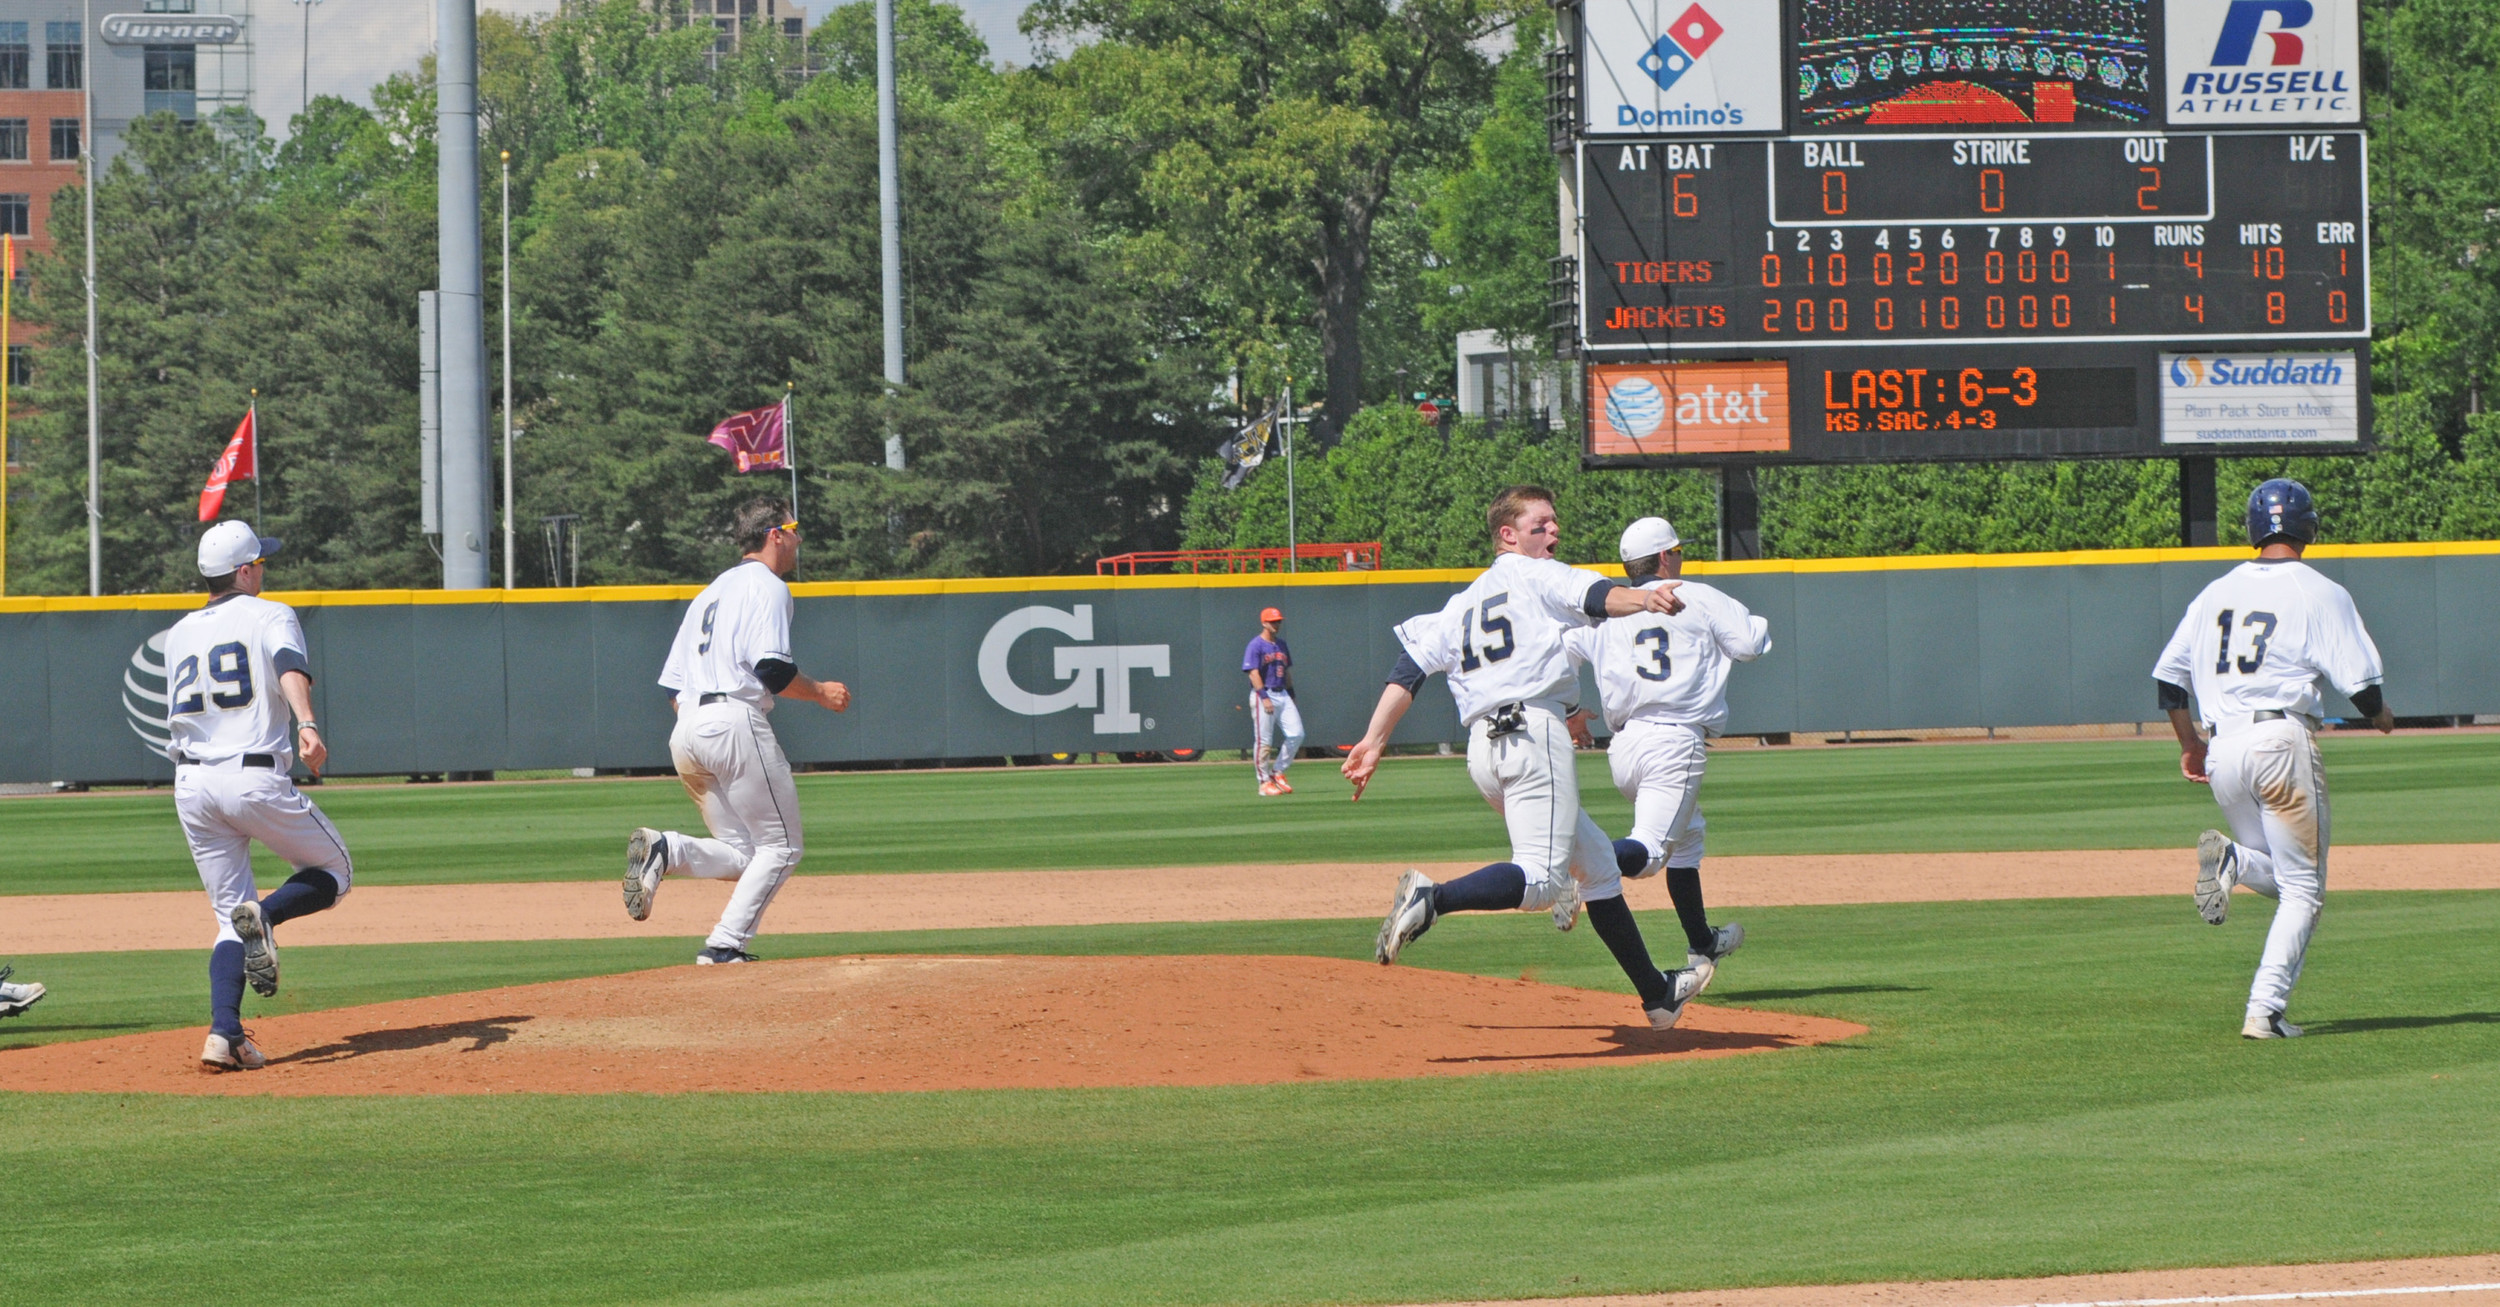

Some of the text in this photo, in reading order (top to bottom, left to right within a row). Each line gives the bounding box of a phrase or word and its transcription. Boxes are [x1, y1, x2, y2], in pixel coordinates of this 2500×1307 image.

[109, 21, 233, 38] Turner
[2181, 71, 2349, 95] RUSSELL
[1617, 102, 1743, 127] Domino's
[2176, 97, 2347, 113] ATHLETIC
[1619, 144, 1714, 171] AT BAT
[1804, 142, 1864, 167] BALL
[1953, 140, 2031, 165] STRIKE
[2125, 138, 2168, 163] OUT
[2290, 136, 2336, 161] H/E
[1673, 173, 1698, 217] 6
[1823, 171, 1847, 215] 0
[1980, 169, 2004, 213] 0
[2137, 167, 2161, 210] 2
[1765, 222, 2355, 251] 1 2 3 4 5 6 7 8 9 10 RUNS HITS ERR
[1615, 261, 1713, 284] TIGERS
[2184, 250, 2202, 279] 4
[2253, 247, 2285, 280] 10
[1605, 306, 1726, 330] JACKETS
[2185, 295, 2204, 323] 4
[2266, 292, 2286, 325] 8
[2210, 357, 2342, 386] Suddath
[1675, 383, 1770, 425] at&t
[2185, 403, 2332, 418] Plan Pack Store Move
[2196, 428, 2318, 440] suddathatlanta.com
[698, 598, 719, 657] 9
[1460, 591, 1516, 674] 15
[2215, 608, 2278, 676] 13
[977, 604, 1171, 734] GT
[1635, 626, 1672, 682] 3
[169, 640, 255, 720] 29
